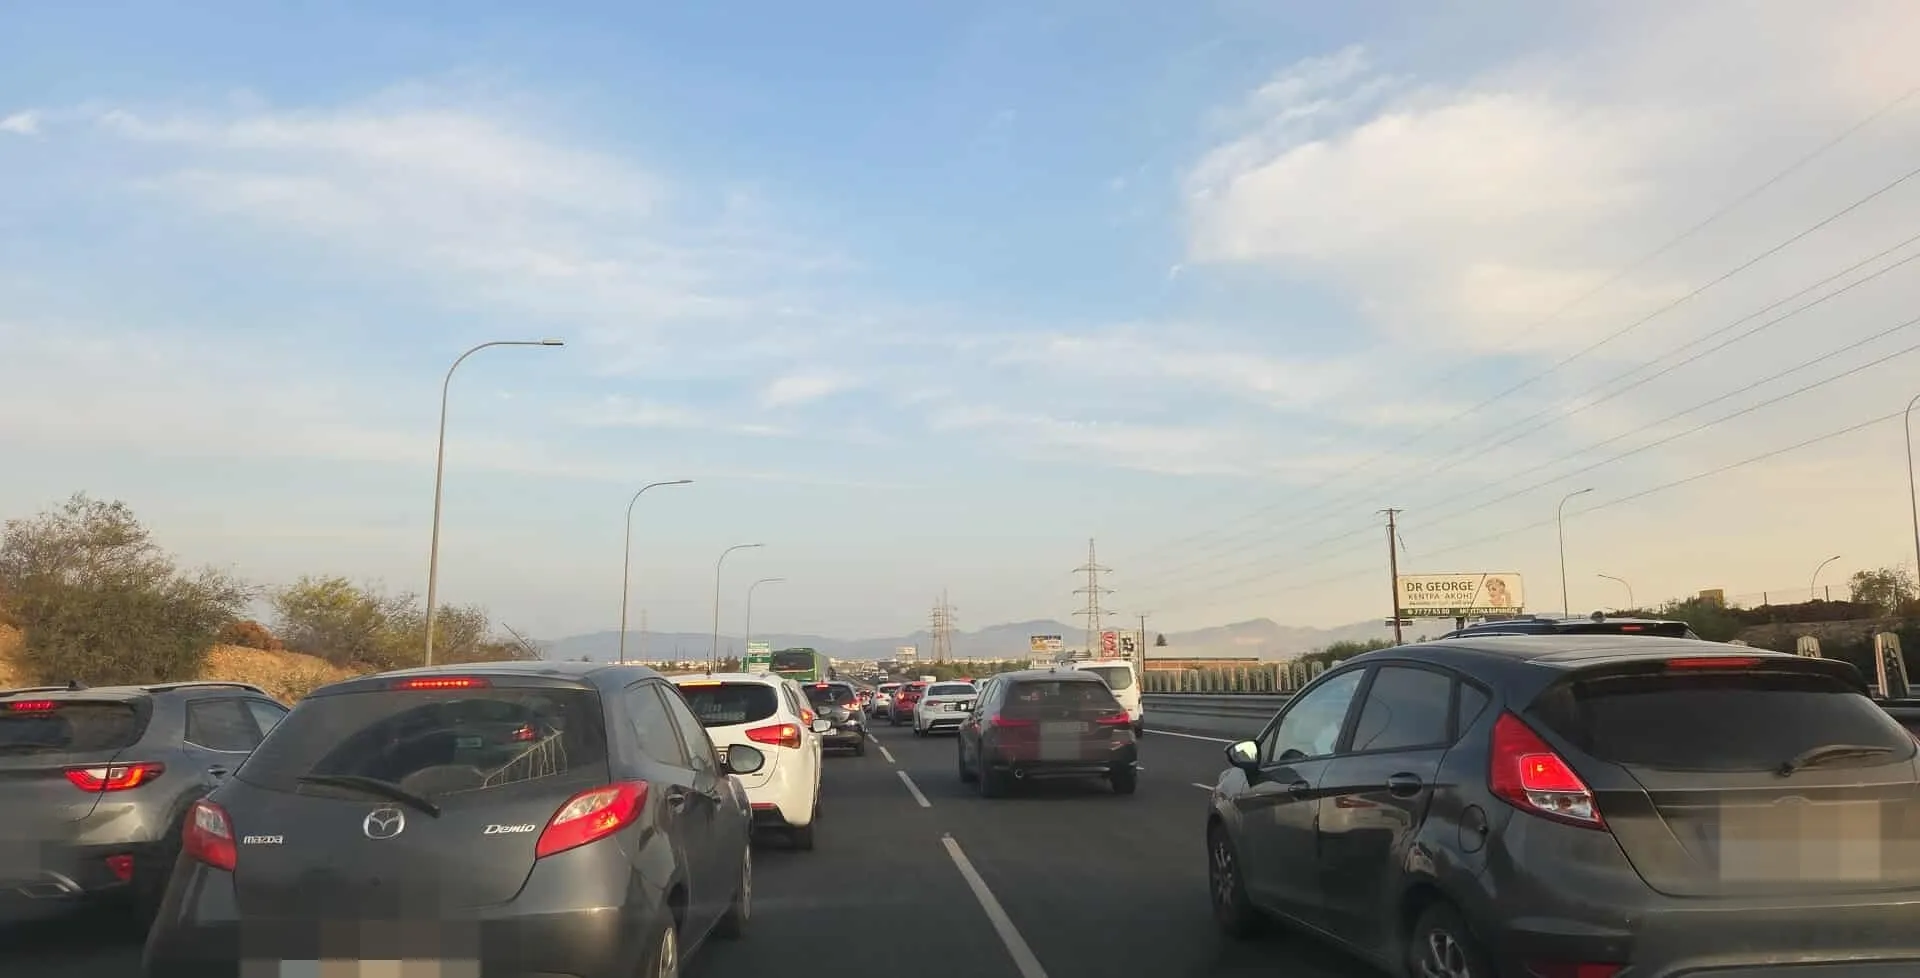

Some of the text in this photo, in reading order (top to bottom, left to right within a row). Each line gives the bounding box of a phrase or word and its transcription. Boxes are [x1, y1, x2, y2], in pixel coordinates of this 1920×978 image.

[1407, 581, 1473, 591] DR GEORGE
[484, 823, 536, 834] Demio
[243, 834, 283, 845] mazda
